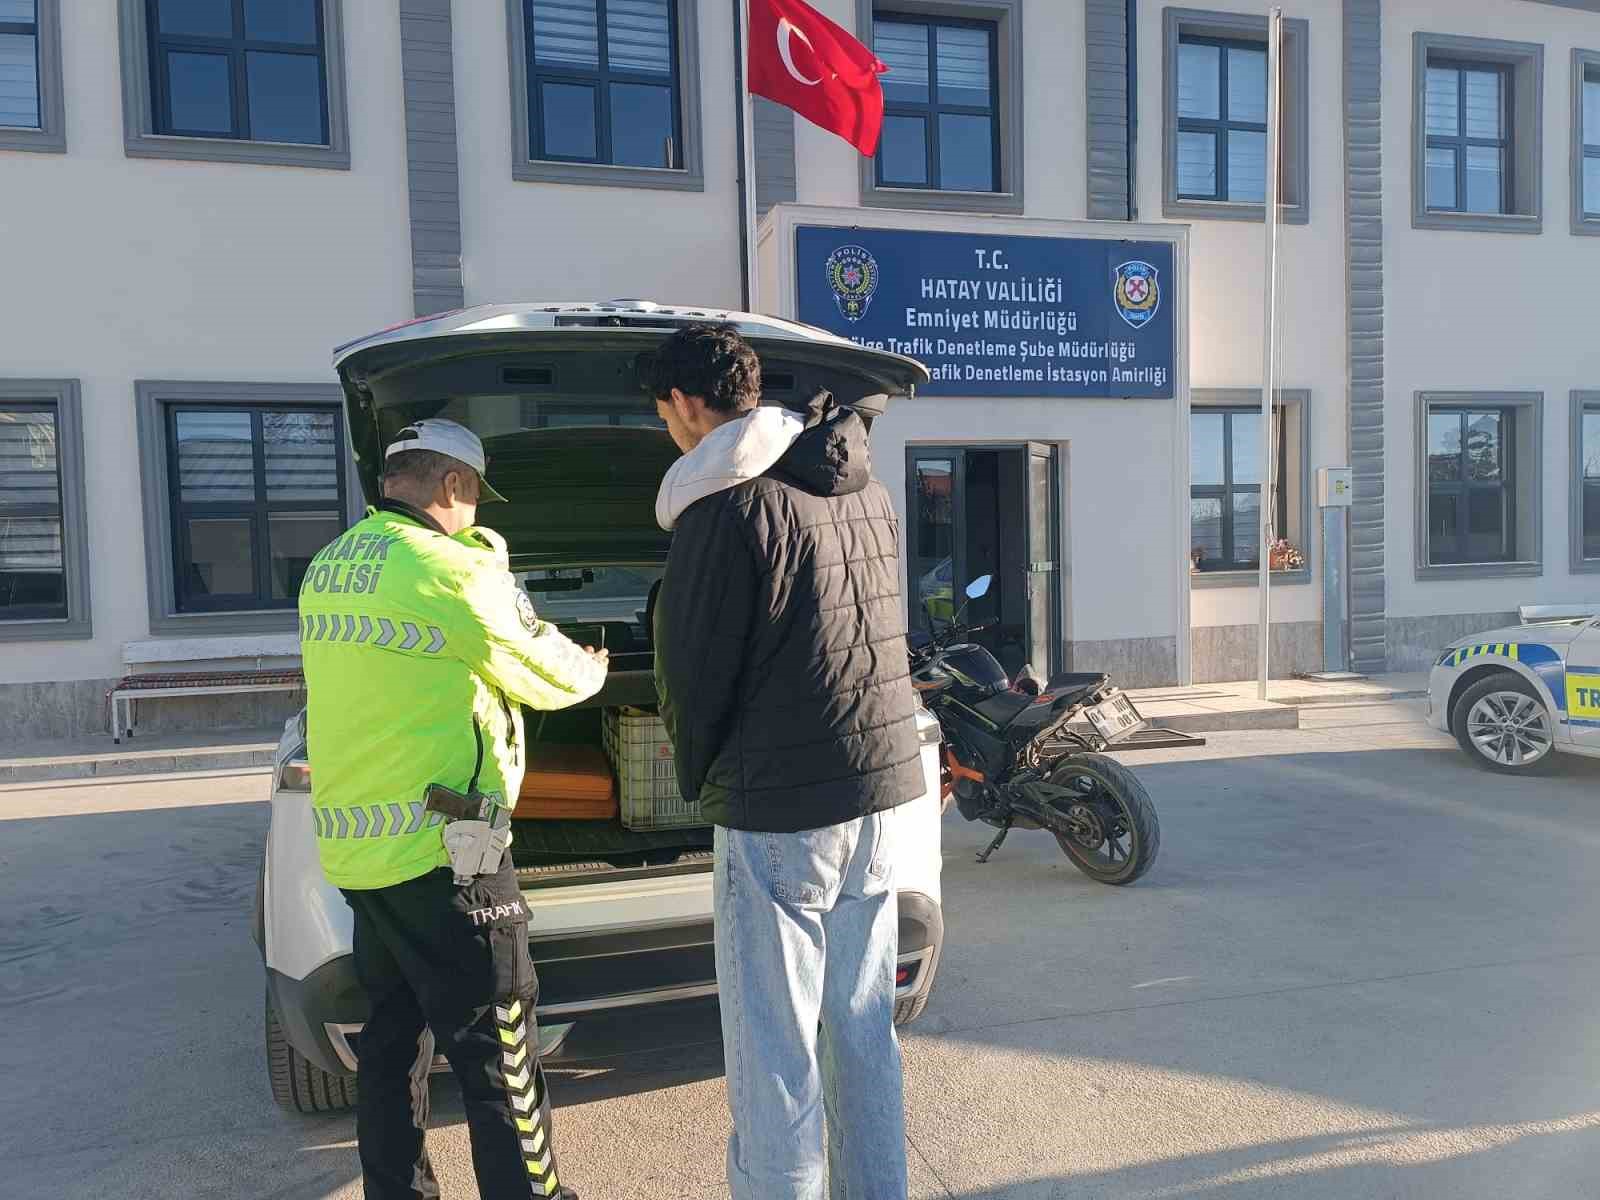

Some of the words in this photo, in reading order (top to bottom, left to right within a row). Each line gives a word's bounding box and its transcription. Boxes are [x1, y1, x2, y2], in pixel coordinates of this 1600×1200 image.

[975, 249, 1009, 269] T.C.
[920, 278, 982, 300] HATAY
[986, 276, 1063, 303] VALİLİĞİ
[905, 307, 980, 333] Emniyet
[984, 309, 1078, 336] Müdürlüğü
[887, 337, 933, 354] Trafik
[937, 339, 1016, 356] Denetleme
[1020, 340, 1055, 362] Şube
[1058, 341, 1136, 362] Müdürlüğü
[966, 364, 1043, 381] Denetleme
[1047, 362, 1108, 386] İstasyon
[1112, 366, 1167, 387] Amirliği
